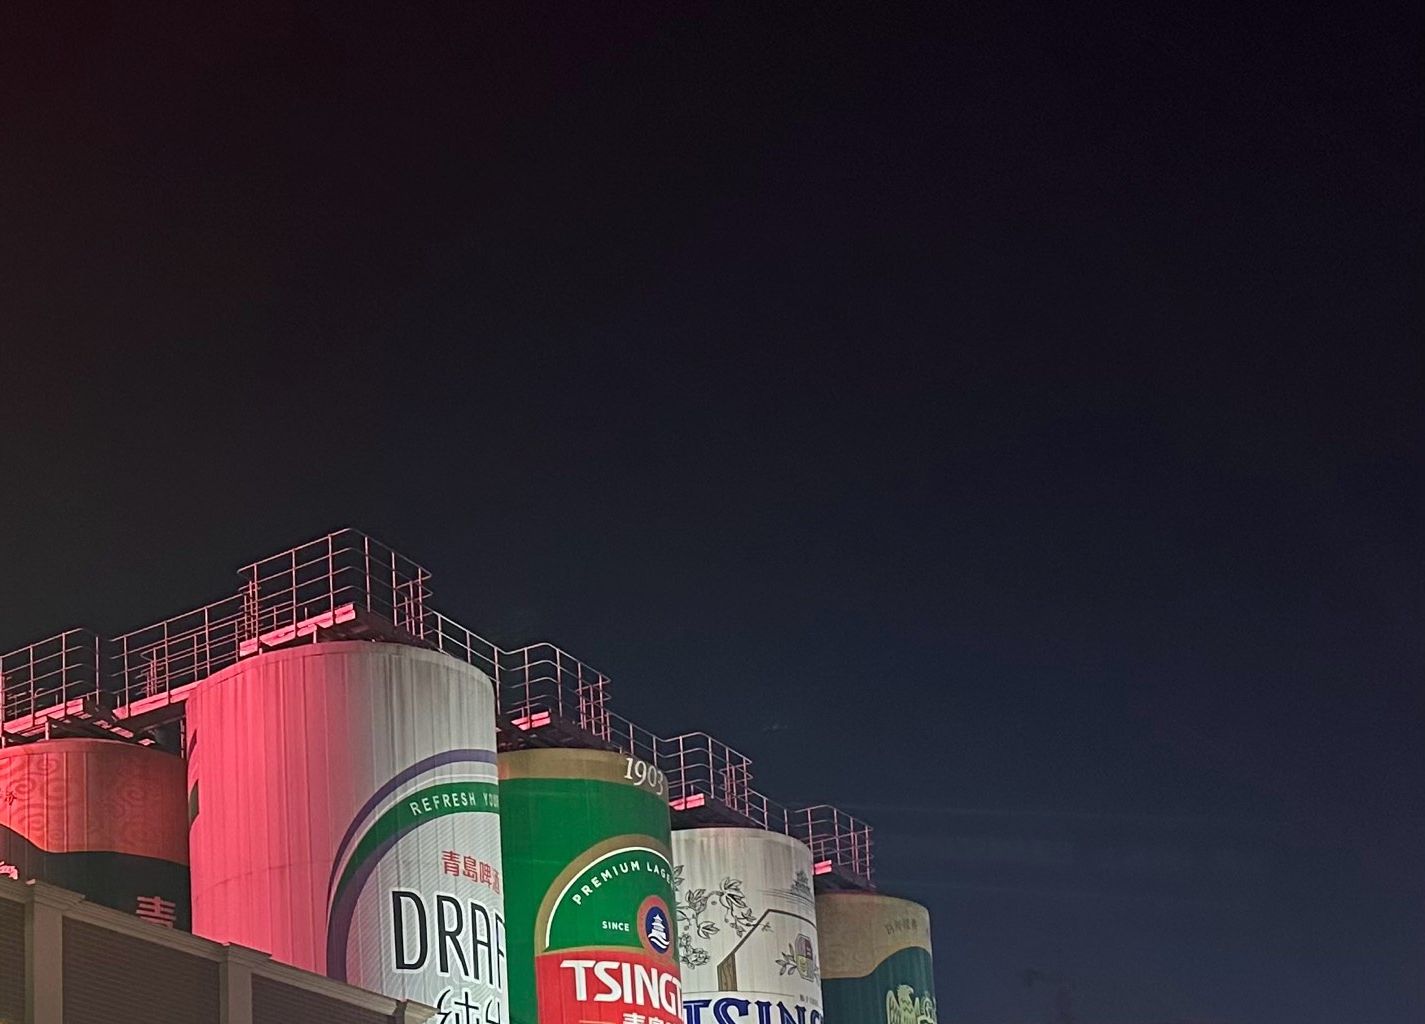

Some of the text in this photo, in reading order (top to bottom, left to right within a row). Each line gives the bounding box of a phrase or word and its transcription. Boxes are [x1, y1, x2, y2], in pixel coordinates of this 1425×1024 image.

[624, 757, 663, 796] 1903
[409, 793, 476, 816] REFRESH
[572, 860, 675, 905] PREMIUM LAGE
[602, 920, 630, 932] SINCE
